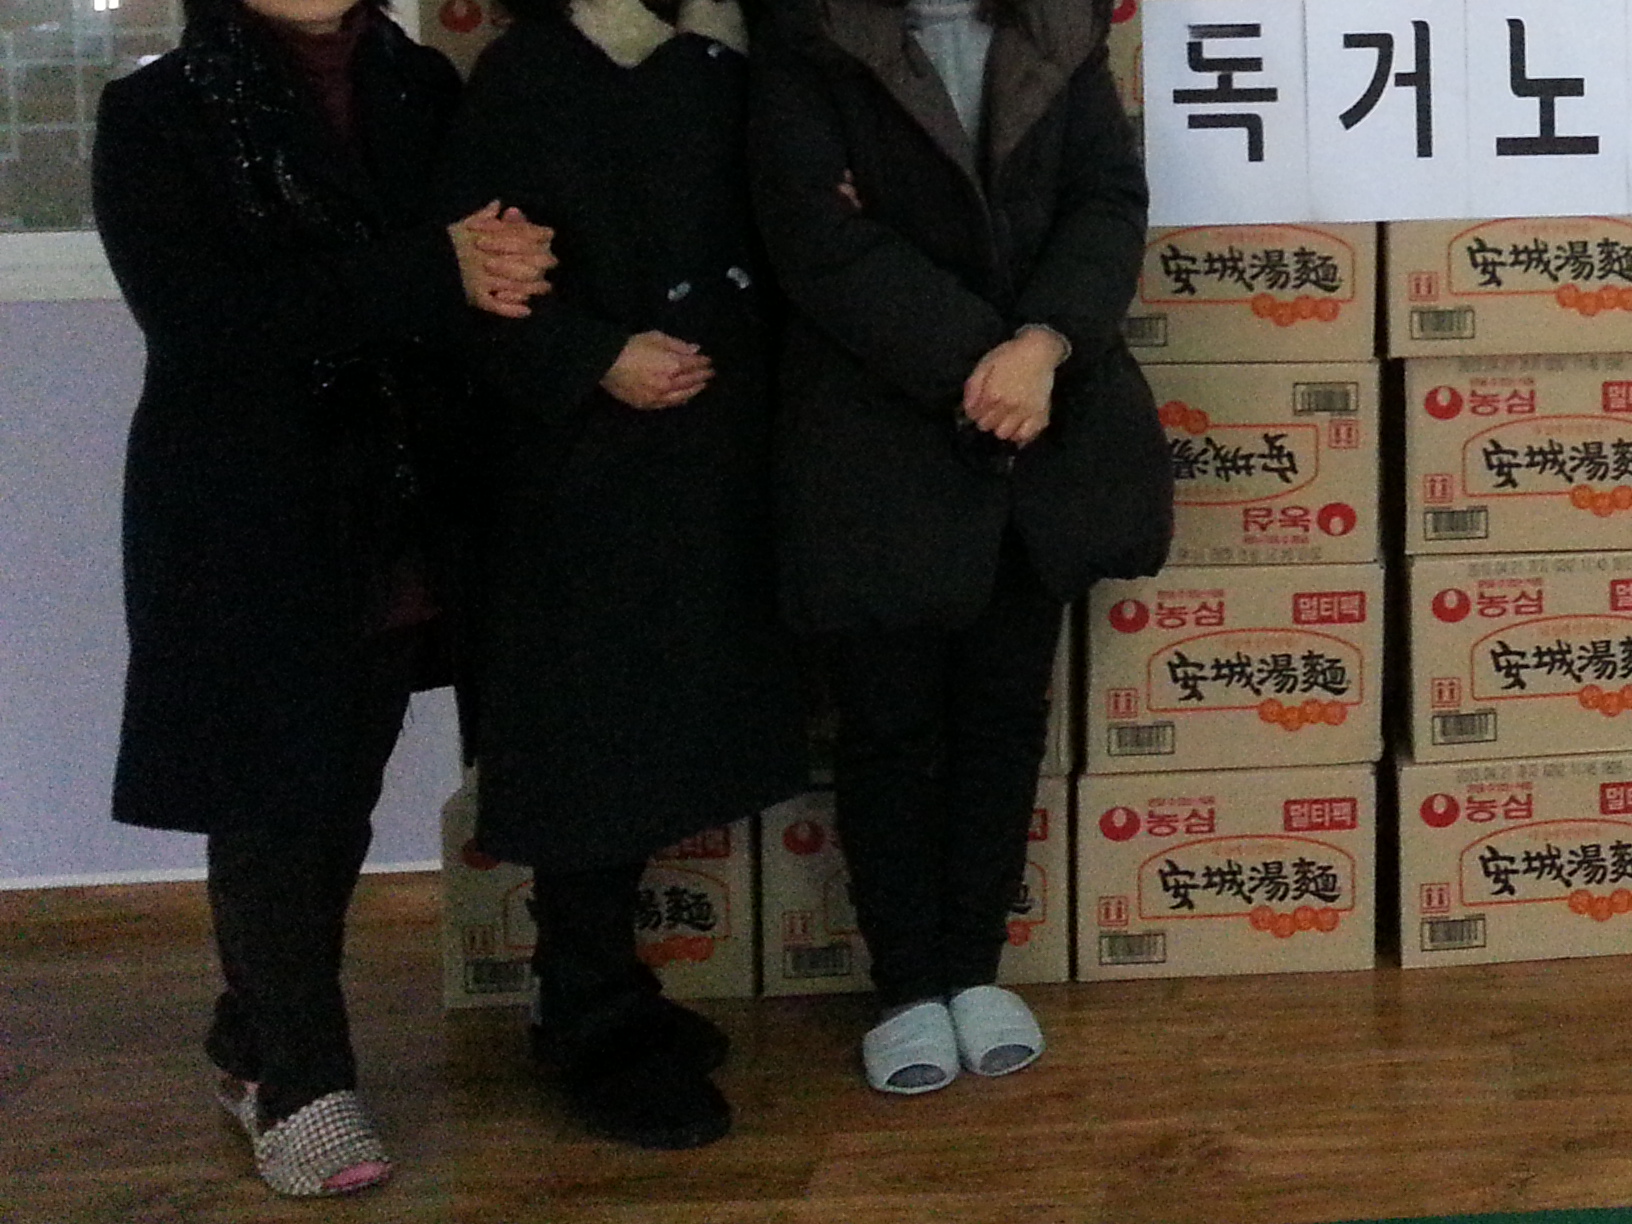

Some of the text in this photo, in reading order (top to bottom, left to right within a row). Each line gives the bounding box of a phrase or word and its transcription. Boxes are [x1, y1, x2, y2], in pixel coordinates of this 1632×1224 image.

[1160, 244, 1342, 295] 安城湯麵
[1469, 389, 1536, 416] 농심
[1154, 601, 1225, 629] 농심
[1298, 595, 1362, 621] 멀티팩
[1476, 589, 1544, 618] 농심
[1166, 650, 1350, 702] 安城湯麵
[1146, 808, 1216, 837] 농심
[1289, 803, 1352, 828] 멀티팩
[1465, 793, 1533, 823] 농심
[1158, 857, 1342, 910] 安城湯麵
